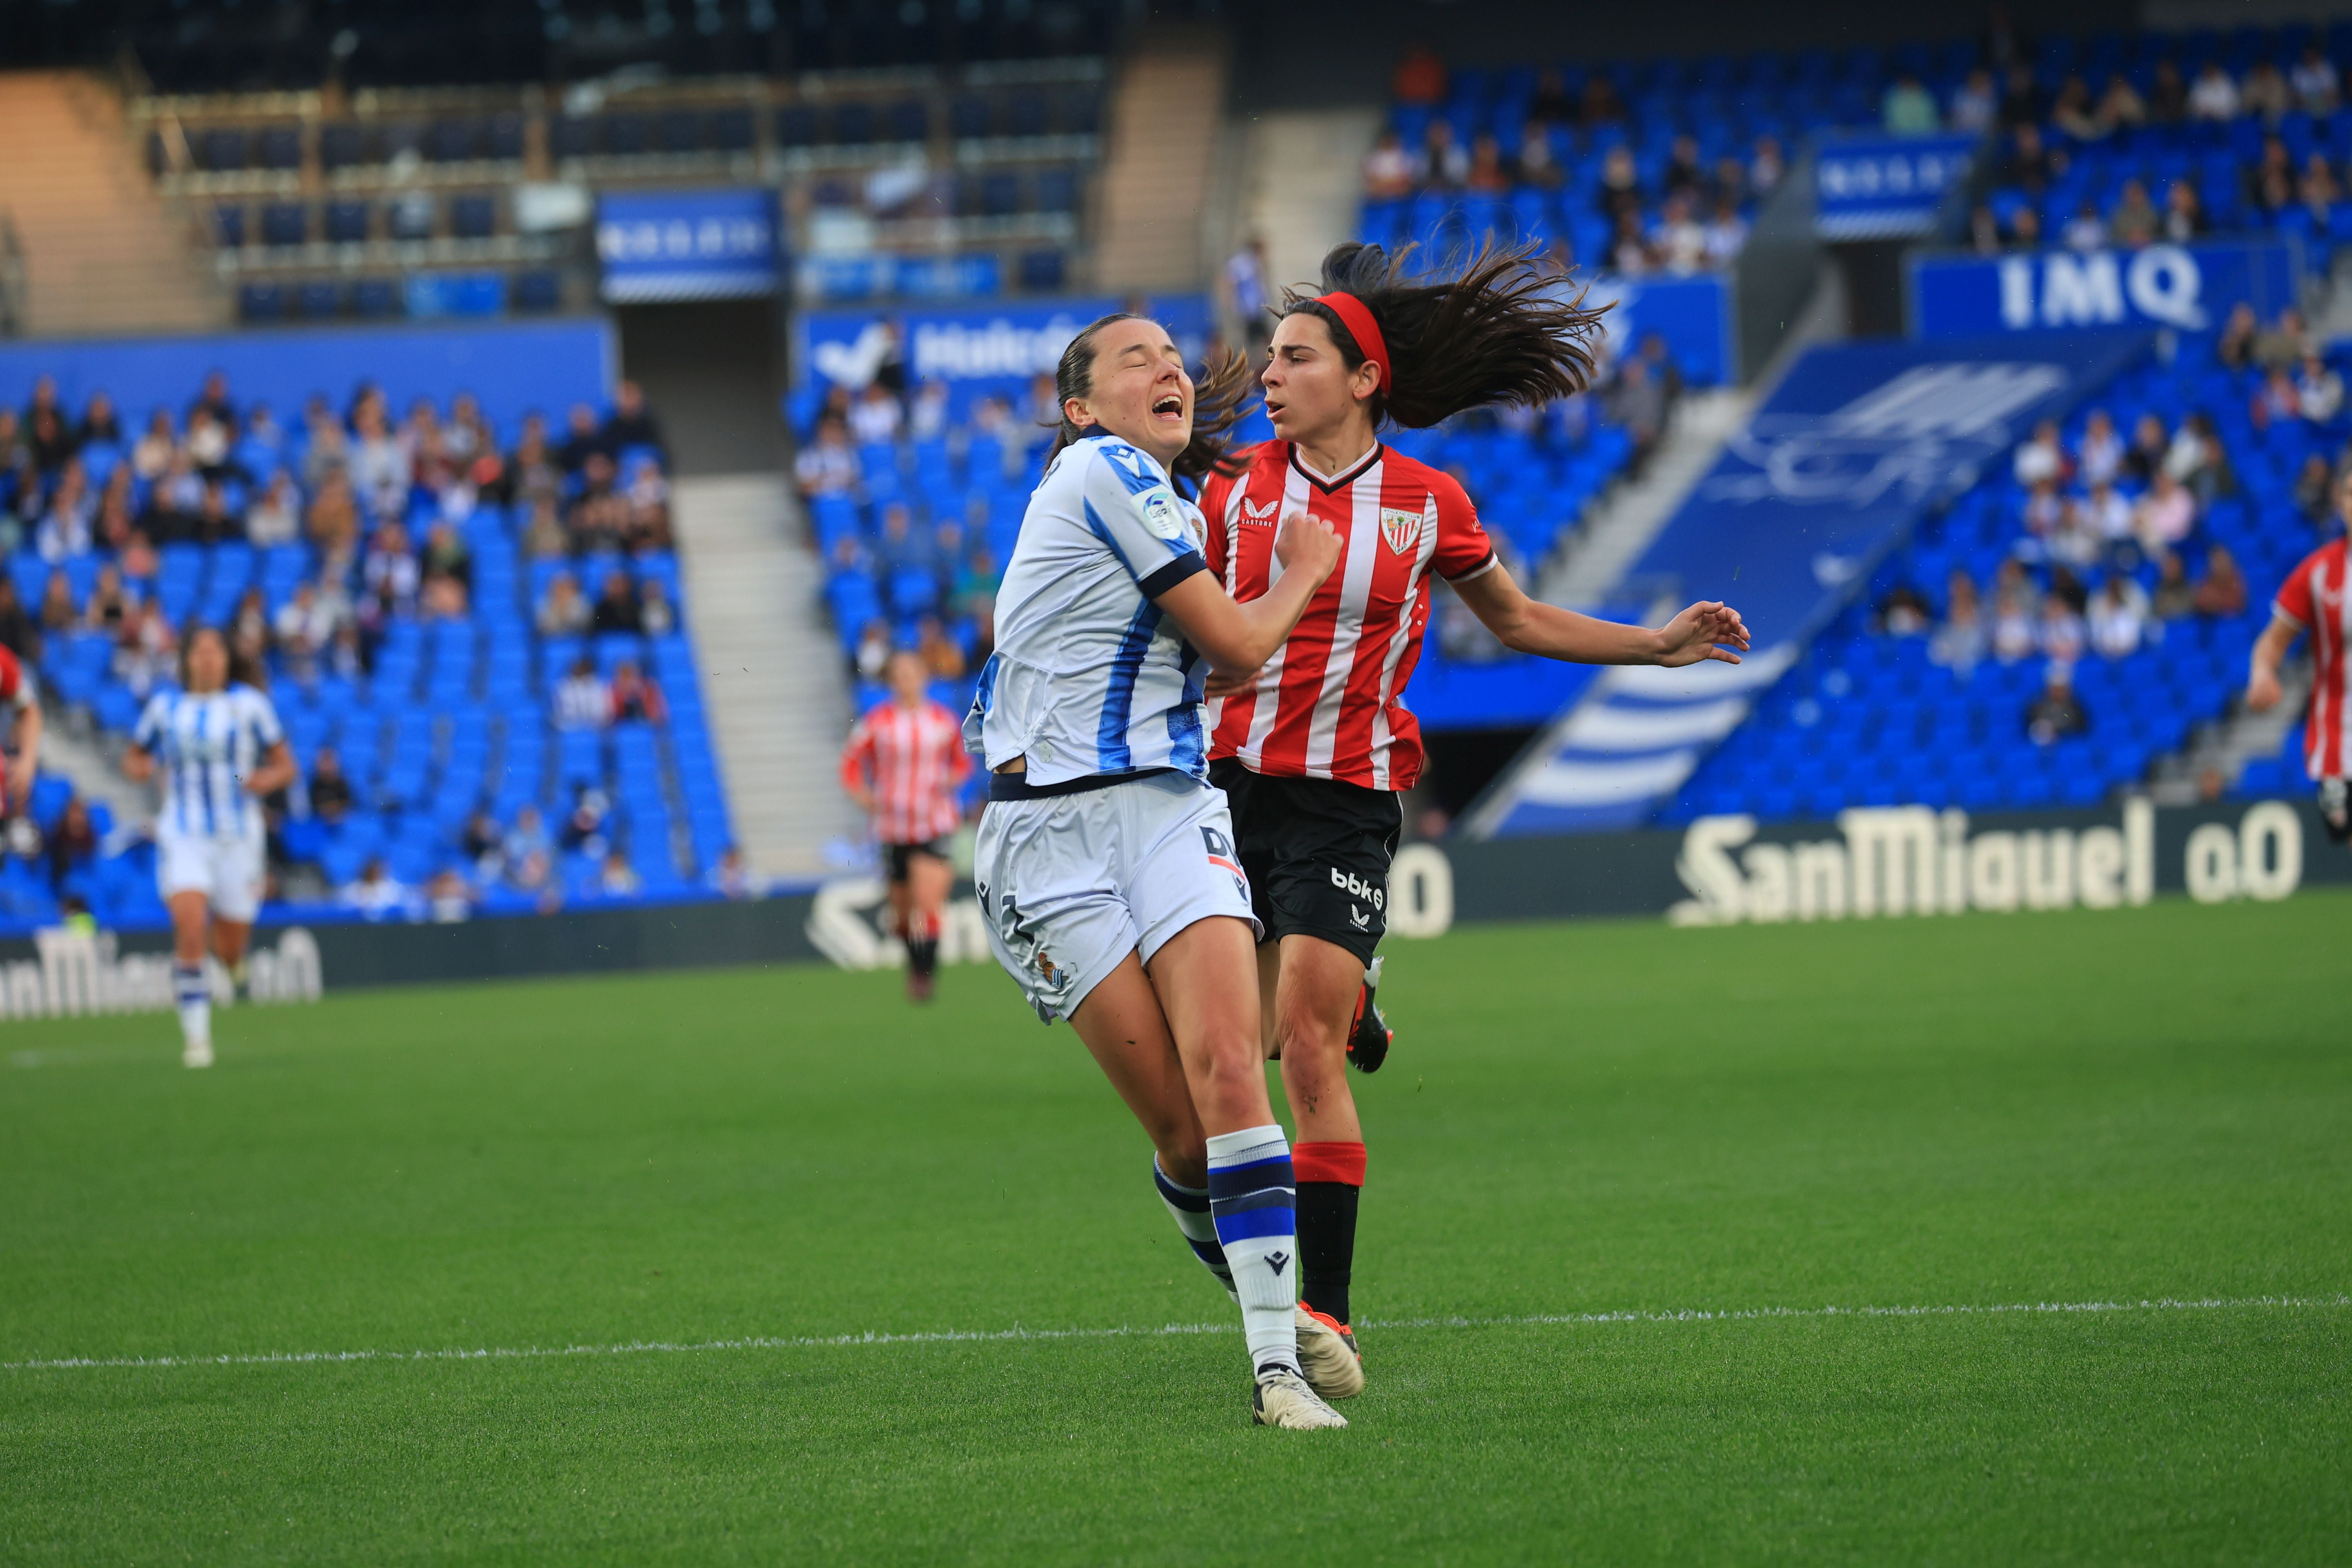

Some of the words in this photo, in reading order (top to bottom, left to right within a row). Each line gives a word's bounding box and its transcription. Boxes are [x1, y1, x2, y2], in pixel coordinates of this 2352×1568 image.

[2001, 245, 2210, 329] IMQ
[1241, 518, 1272, 527] CASTORE
[1390, 540, 1407, 554] BILBAO
[1331, 867, 1372, 903] bbk
